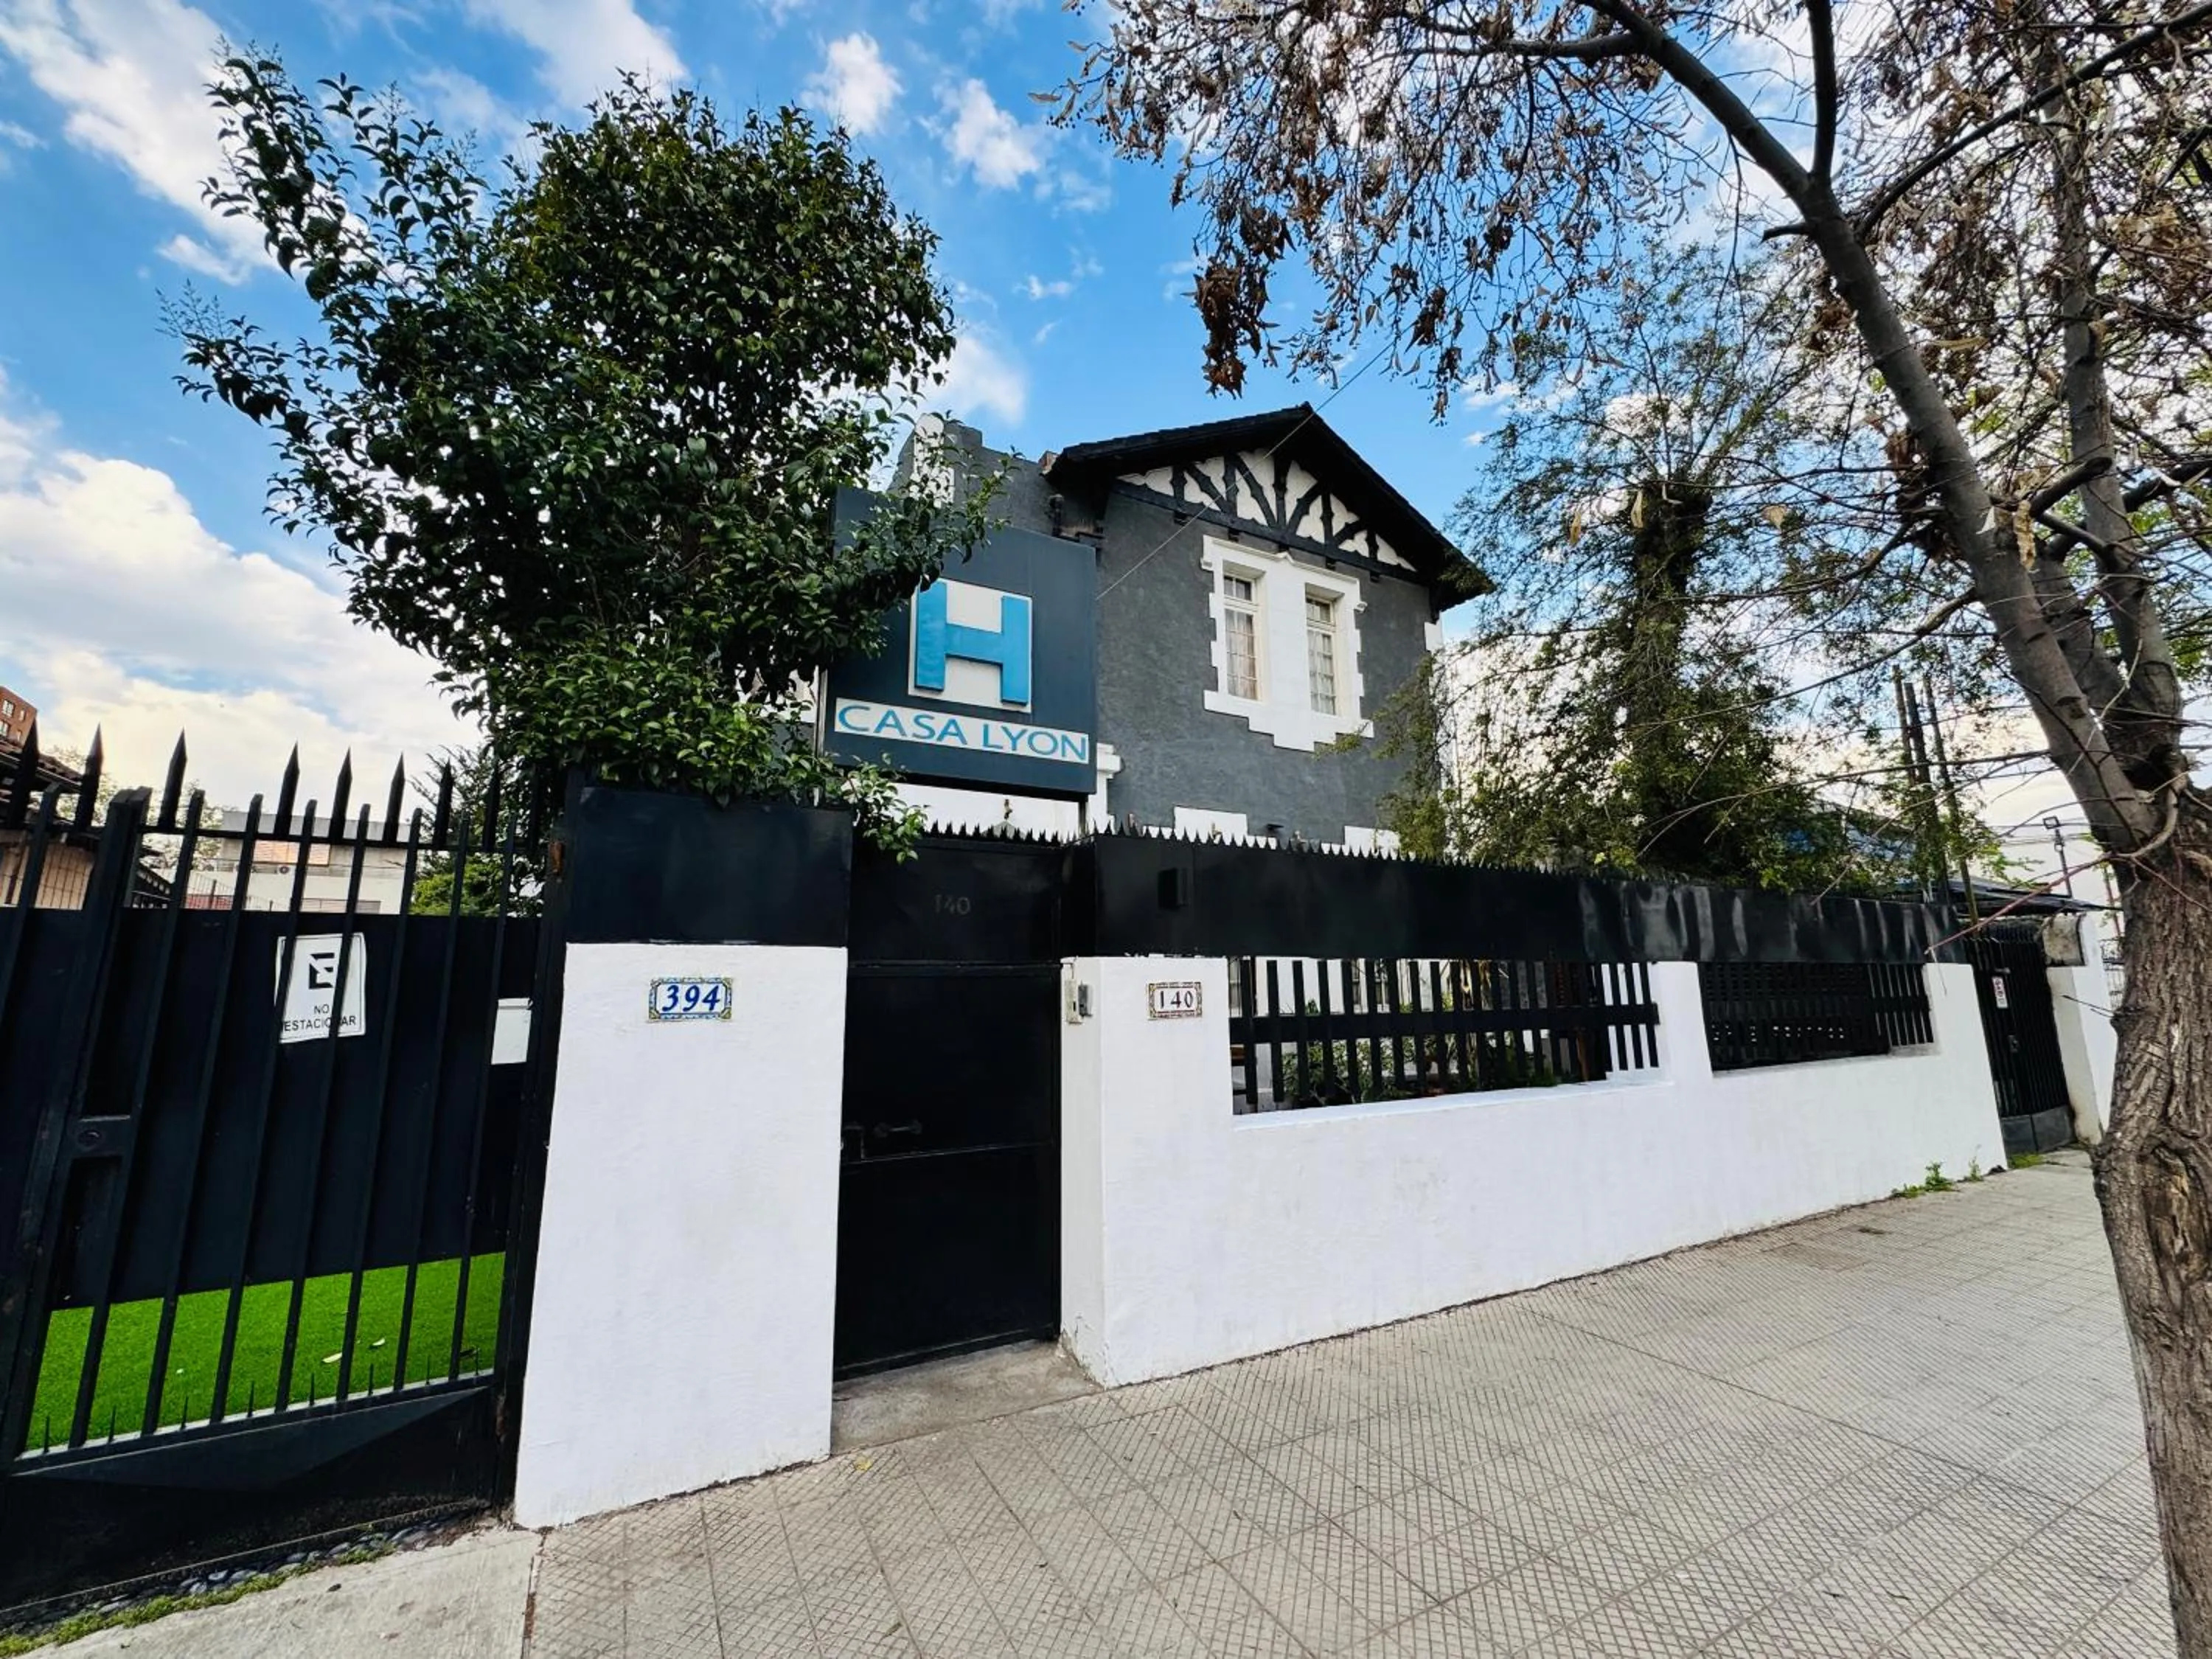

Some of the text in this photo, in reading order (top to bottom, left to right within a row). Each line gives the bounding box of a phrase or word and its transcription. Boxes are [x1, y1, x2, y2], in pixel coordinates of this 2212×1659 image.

[914, 580, 1030, 706] H
[838, 703, 1087, 762] CASA LYON
[935, 894, 970, 914] 140
[661, 984, 720, 1012] 394
[1160, 990, 1194, 1009] 140
[313, 1004, 330, 1015] NO
[283, 1015, 356, 1032] ESTACIOAR
